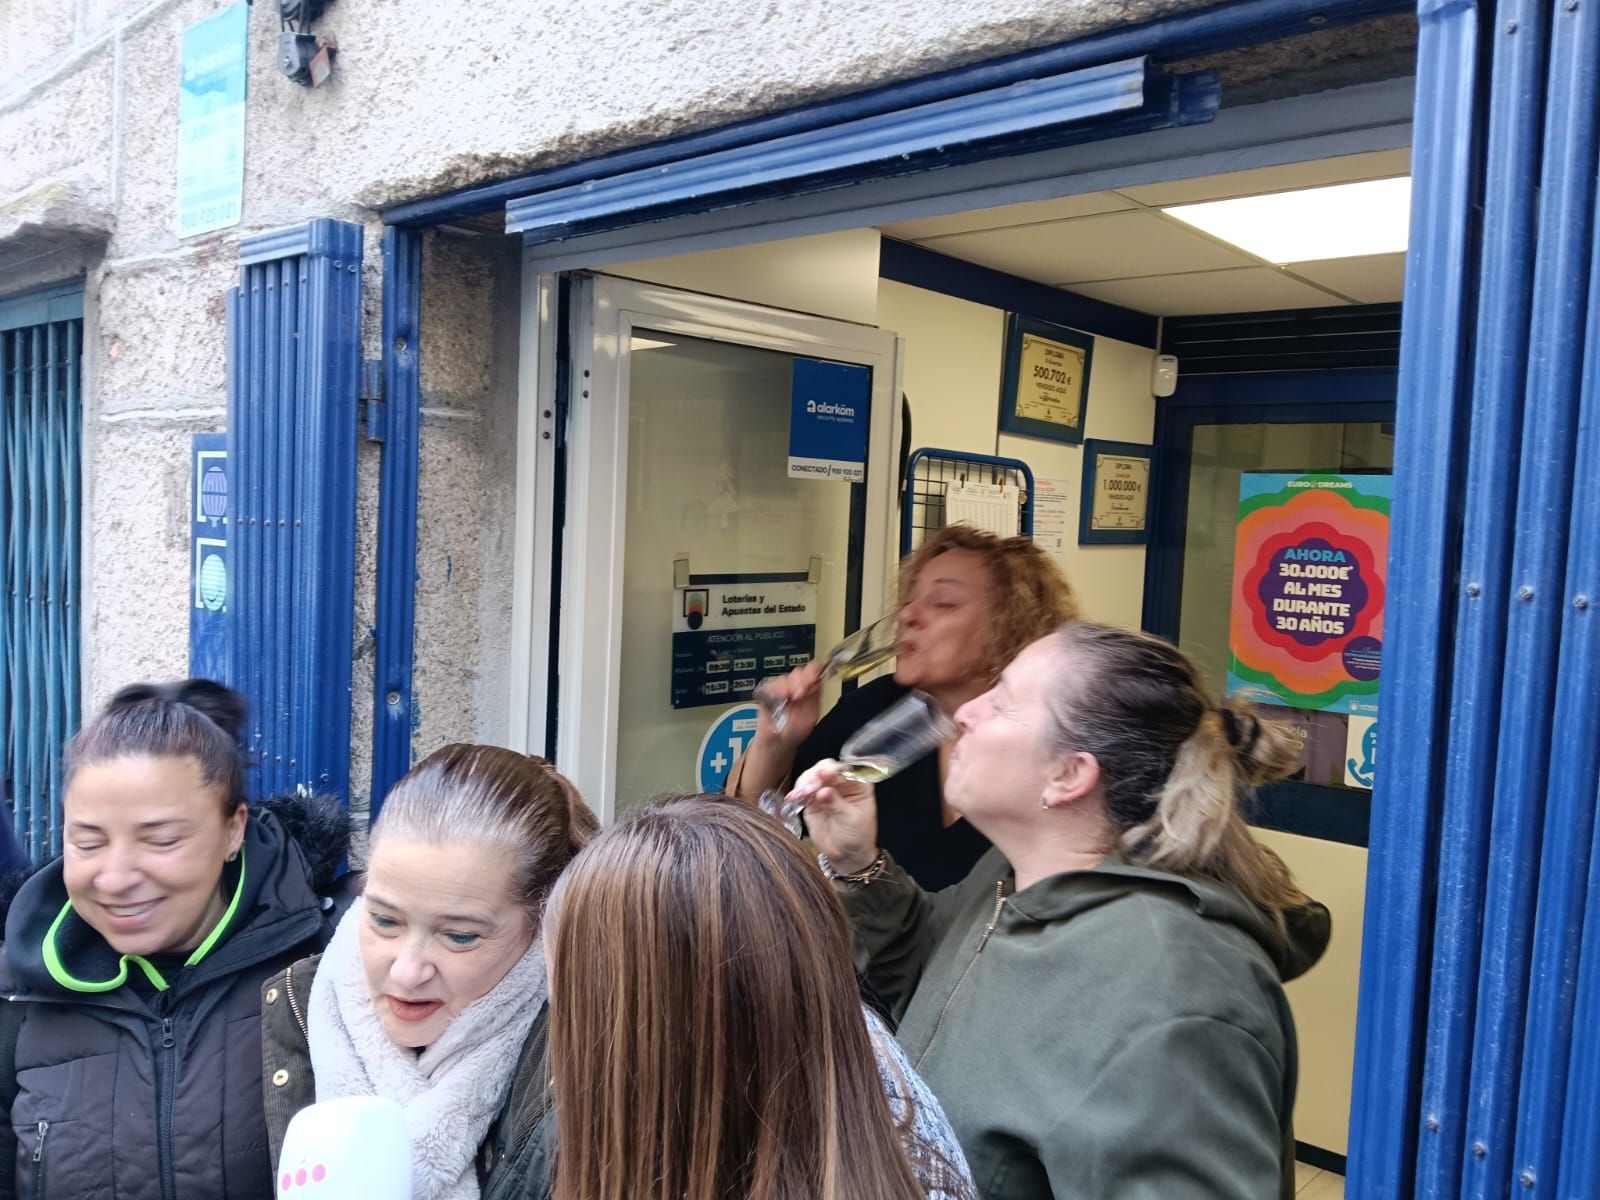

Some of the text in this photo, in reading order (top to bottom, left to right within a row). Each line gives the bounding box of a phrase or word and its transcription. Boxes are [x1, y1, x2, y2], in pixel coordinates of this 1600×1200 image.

[1033, 364, 1066, 384] 500.702
[1103, 479, 1136, 492] 1.000.000
[1284, 548, 1347, 562] AHORA
[1283, 581, 1342, 598] AL MES
[759, 595, 766, 604] y
[721, 603, 806, 617] Apuestas del Estado
[1273, 598, 1351, 617] DURANTE
[1276, 616, 1345, 635] 30 AÑOS
[744, 633, 754, 642] AL
